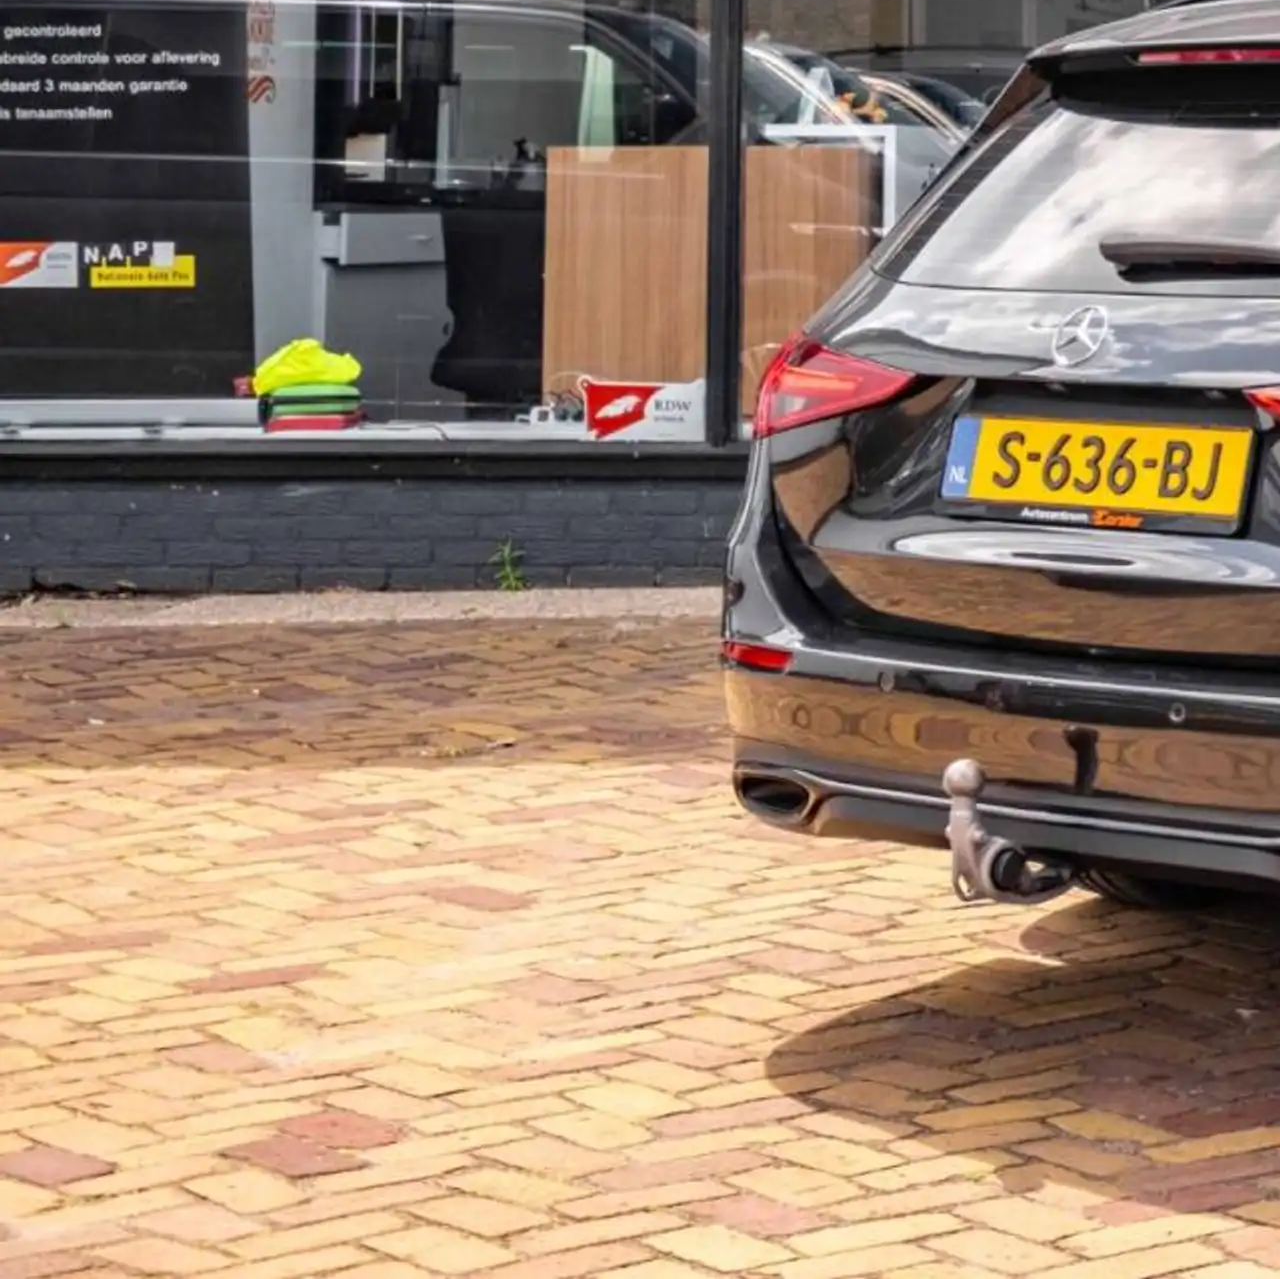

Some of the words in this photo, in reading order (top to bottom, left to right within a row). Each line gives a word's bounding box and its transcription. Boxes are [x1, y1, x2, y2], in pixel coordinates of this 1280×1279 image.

[4, 24, 102, 40] gecontroleerd
[52, 51, 110, 64] controle
[114, 53, 147, 64] voor
[151, 51, 220, 67] aflevering
[45, 78, 54, 92] 3
[59, 79, 124, 92] maanden
[129, 79, 188, 94] garantie
[15, 106, 113, 120] tenaamstellen
[991, 430, 1224, 502] S-636-BJ
[949, 465, 968, 485] NL
